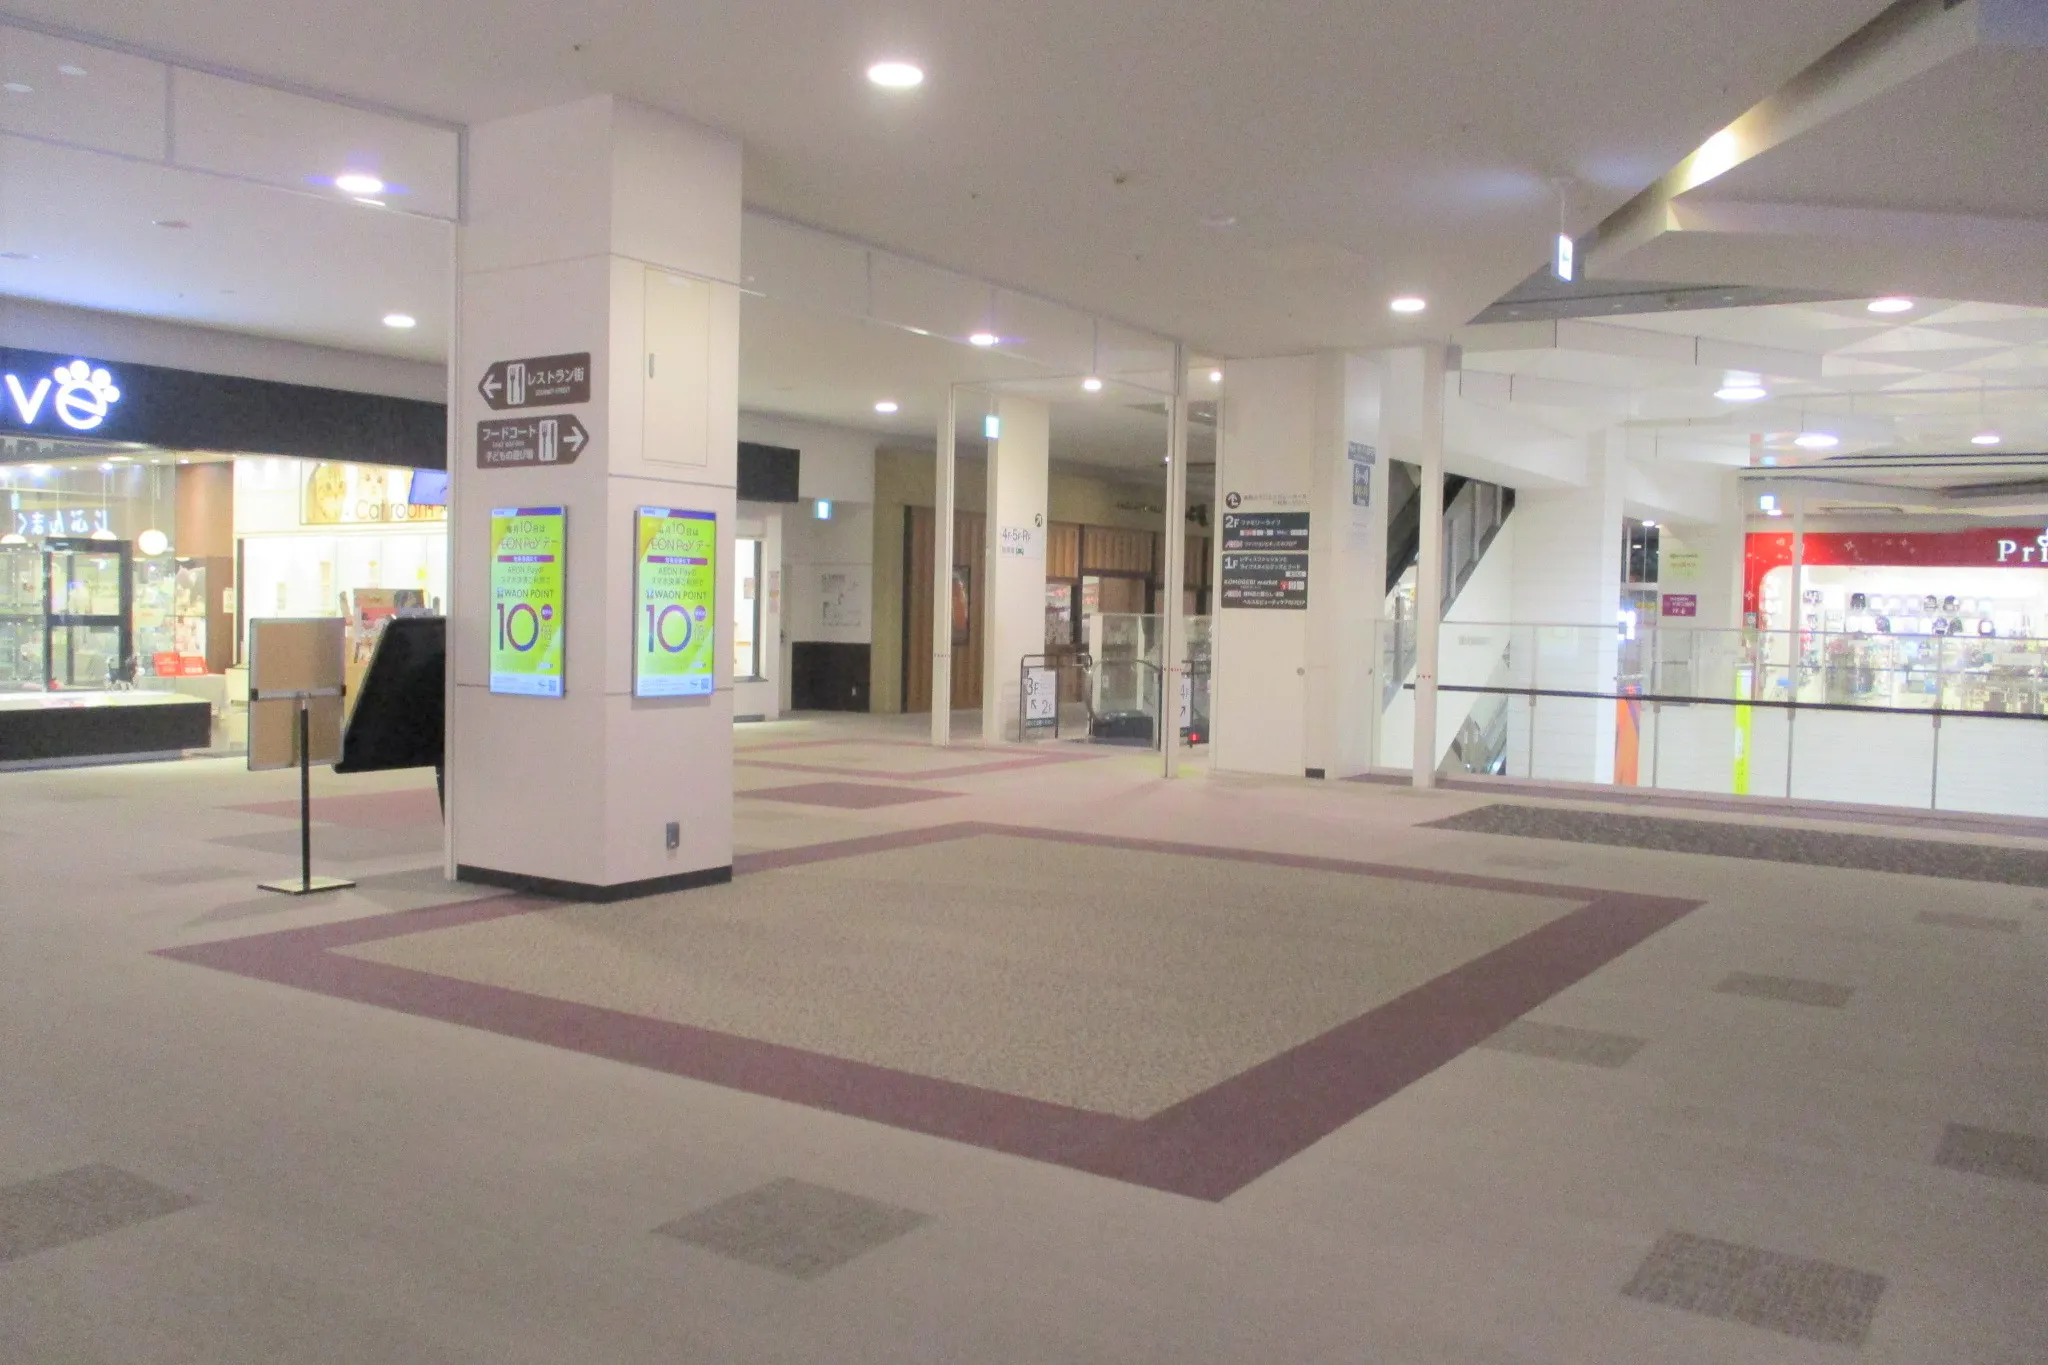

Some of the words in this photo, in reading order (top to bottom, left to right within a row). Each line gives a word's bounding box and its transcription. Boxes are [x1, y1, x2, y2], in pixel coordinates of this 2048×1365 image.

[527, 366, 584, 387] レストラン街
[482, 424, 536, 441] フードコート
[355, 500, 386, 521] Cat
[1225, 515, 1240, 529] 2F
[1224, 556, 1239, 570] 1F
[504, 588, 529, 599] WAON
[530, 588, 554, 599] POINT
[655, 590, 681, 600] WAON
[683, 591, 707, 600] POINT
[1024, 677, 1039, 696] 3F
[1041, 699, 1052, 715] 2F
